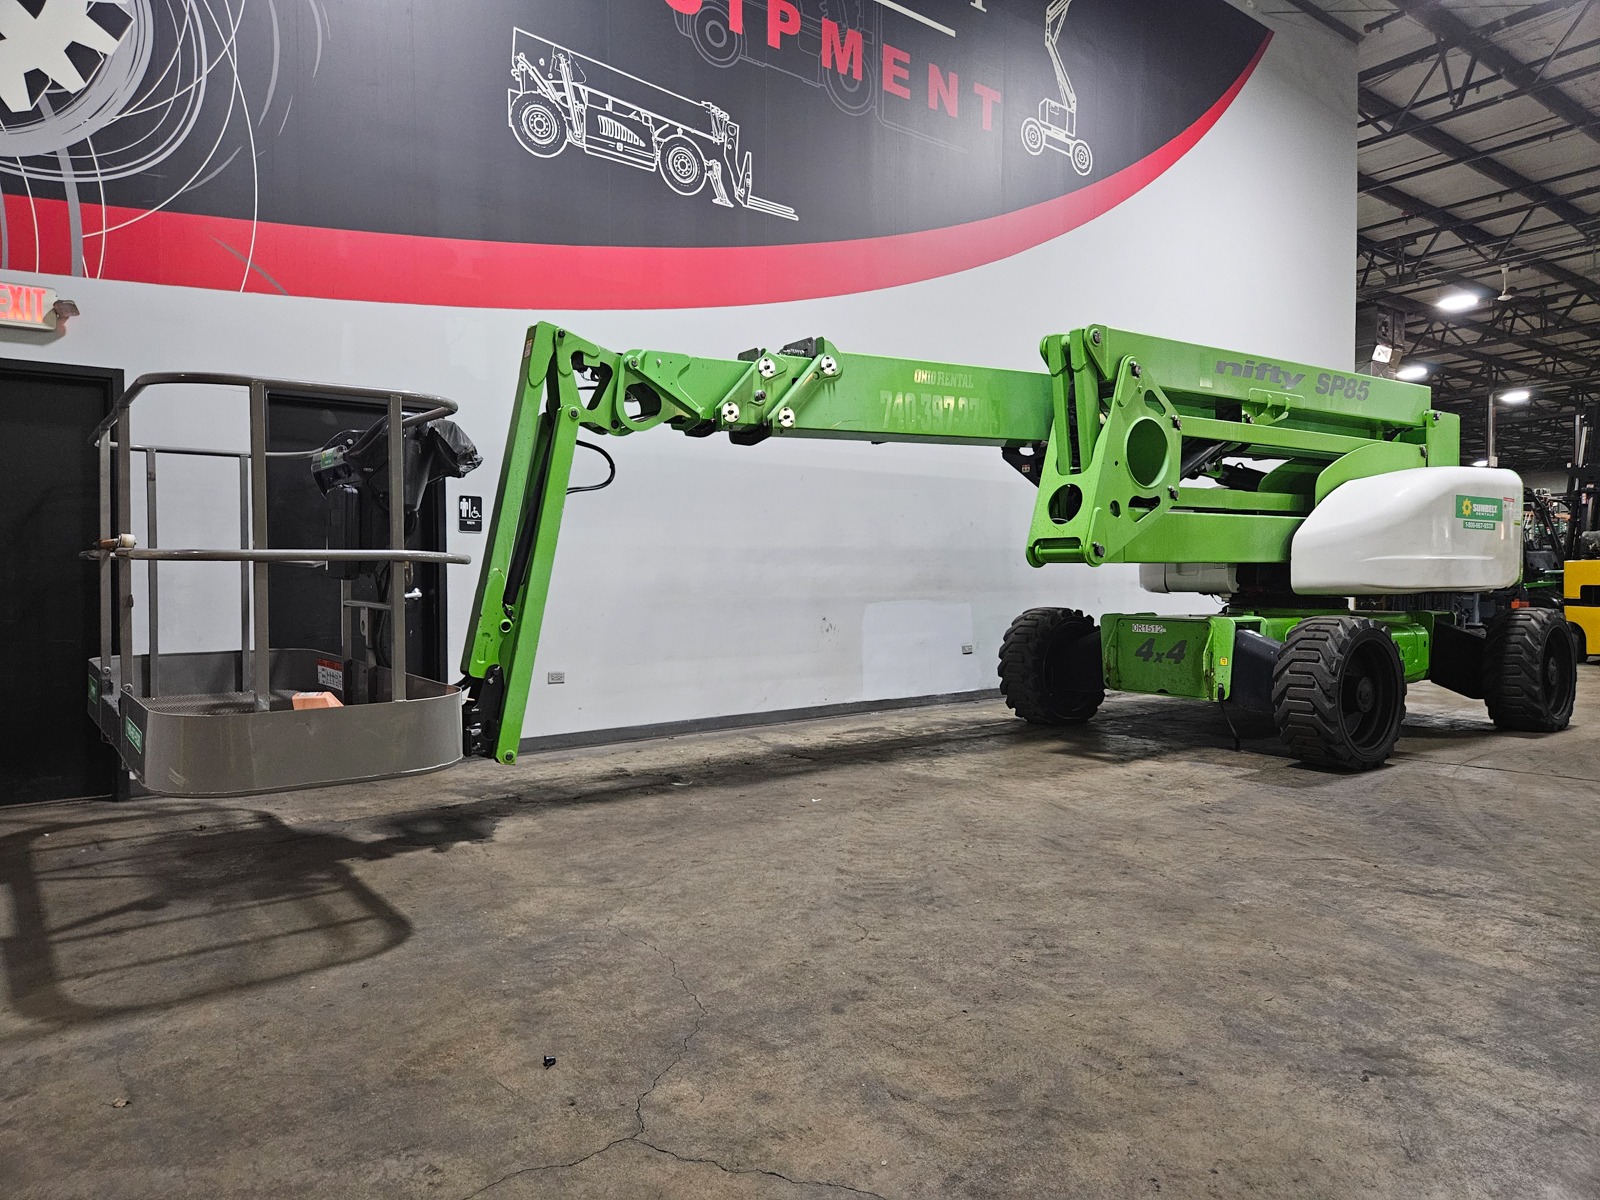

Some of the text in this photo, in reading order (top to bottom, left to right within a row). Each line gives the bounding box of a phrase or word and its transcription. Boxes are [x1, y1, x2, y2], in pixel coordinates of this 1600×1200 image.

[664, 0, 1001, 131] IPMENT
[0, 284, 46, 323] EXIT
[914, 369, 936, 385] OHIO
[1215, 360, 1371, 401] nifty SP85
[1472, 503, 1498, 513] SUNBELT
[1134, 637, 1188, 665] 4x4
